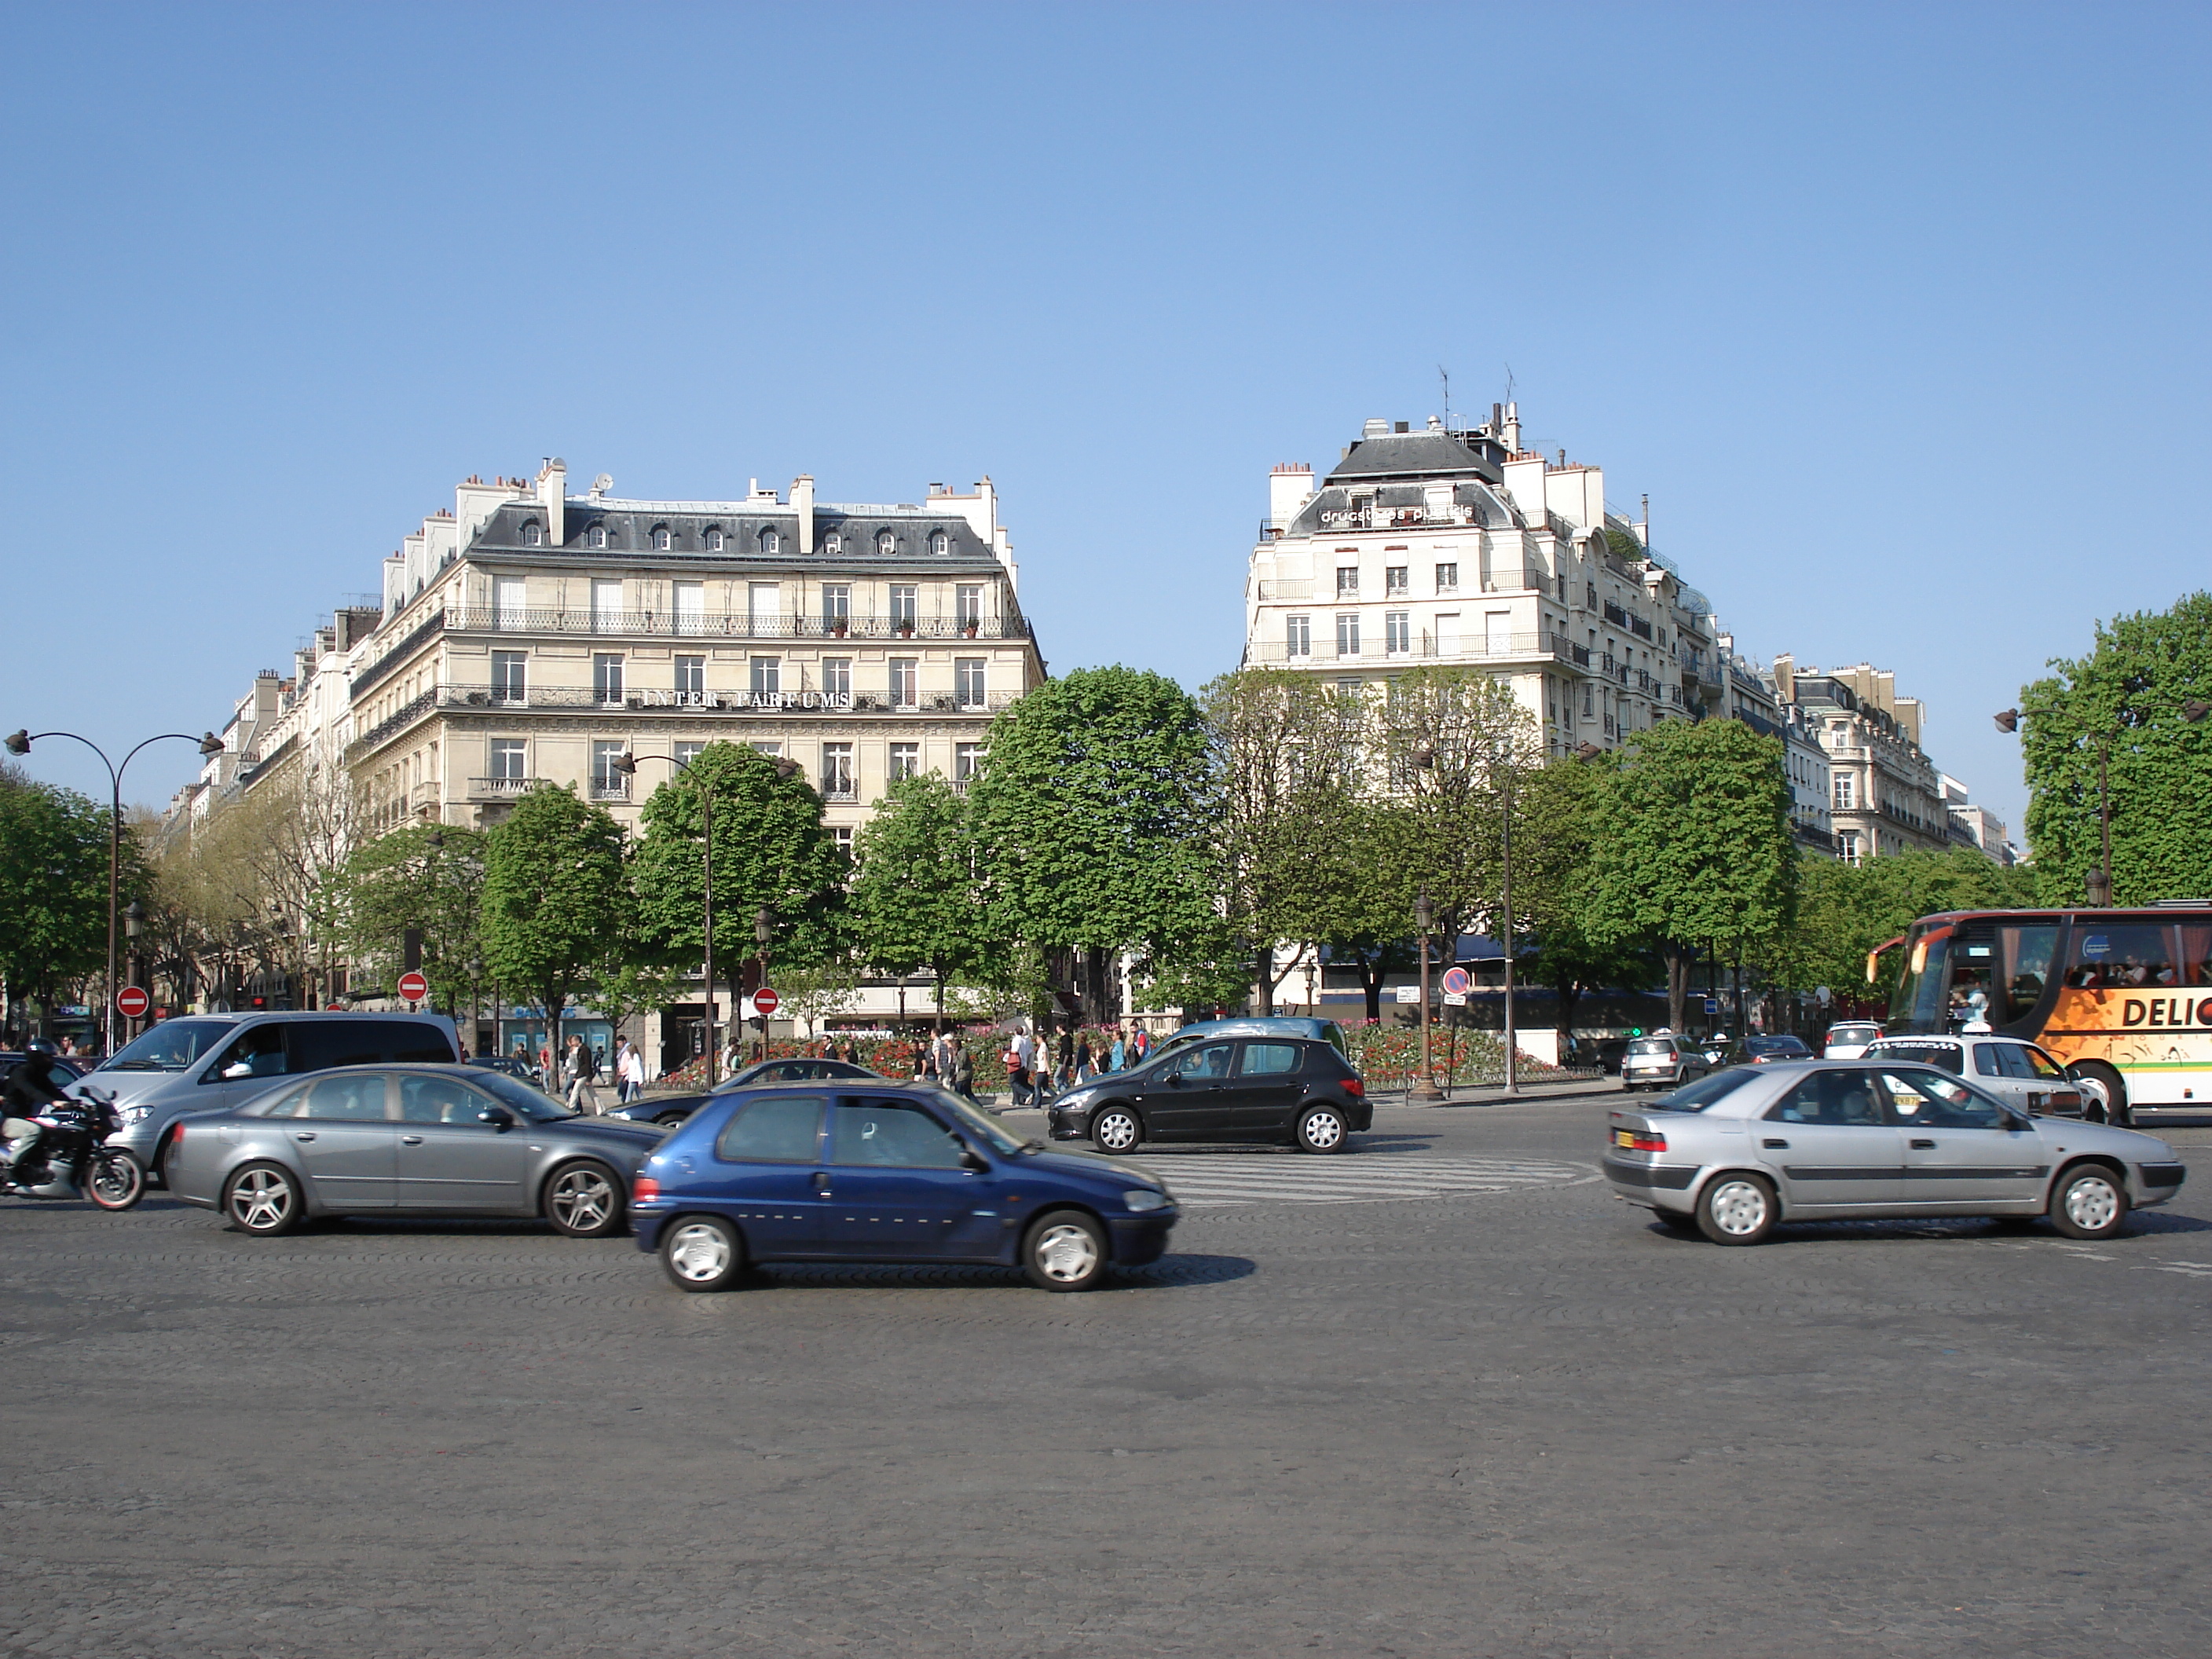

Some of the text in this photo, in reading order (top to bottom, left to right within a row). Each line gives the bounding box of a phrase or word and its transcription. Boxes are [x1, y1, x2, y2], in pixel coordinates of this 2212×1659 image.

[1413, 505, 1473, 521] pucis
[643, 691, 850, 709] INTER PARFUMS
